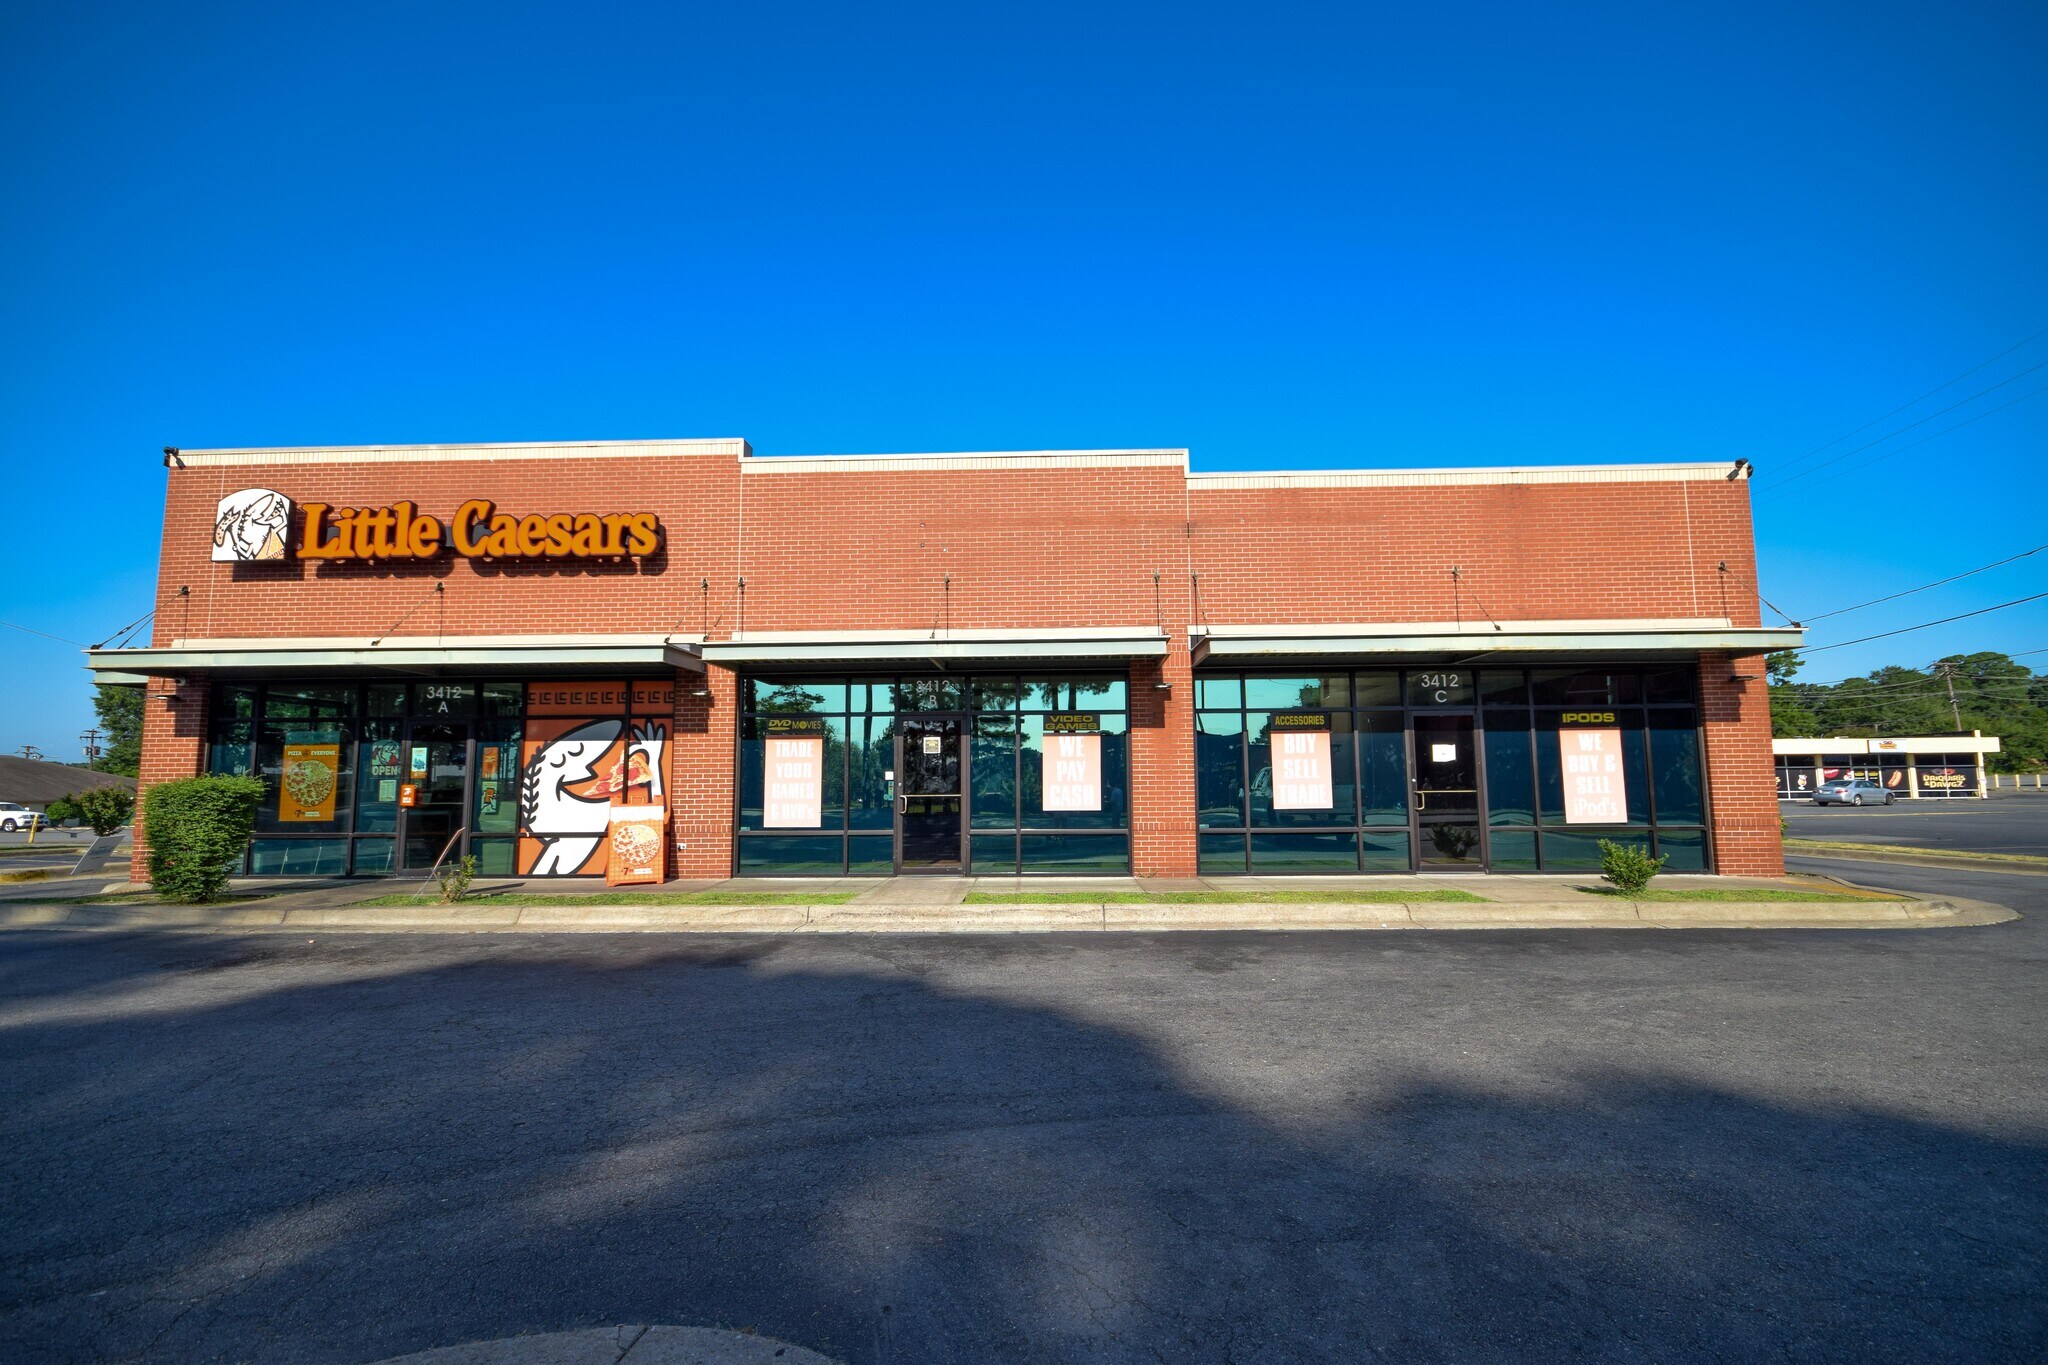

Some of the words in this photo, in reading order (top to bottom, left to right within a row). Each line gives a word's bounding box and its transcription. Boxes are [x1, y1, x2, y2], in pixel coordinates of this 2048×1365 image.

[297, 500, 441, 559] Little
[452, 499, 660, 557] Caesars
[916, 680, 950, 693] 3412
[1421, 674, 1459, 688] 3412
[426, 686, 462, 699] 3412
[1435, 690, 1447, 703] C
[438, 701, 449, 713] A
[929, 694, 938, 708] B
[768, 719, 792, 731] DVD
[792, 719, 821, 730] MOVIES
[1045, 722, 1097, 730] GAMES
[1049, 715, 1093, 723] VIDEO
[1274, 715, 1325, 726] ACCESSORIES
[1562, 713, 1615, 723] IPODS
[775, 741, 814, 758] TRADE
[1058, 736, 1085, 757] WE
[1283, 733, 1317, 754] BUY
[1578, 733, 1603, 751] WE
[371, 765, 398, 776] OPEN
[776, 762, 812, 778] YOUR
[1056, 761, 1086, 782] PAY
[1283, 759, 1320, 780] SELL
[1568, 755, 1600, 773] BUY
[772, 782, 814, 800] GAMES
[1576, 776, 1611, 795] SELL
[1050, 784, 1095, 806] CASH
[1278, 784, 1328, 805] TRADE
